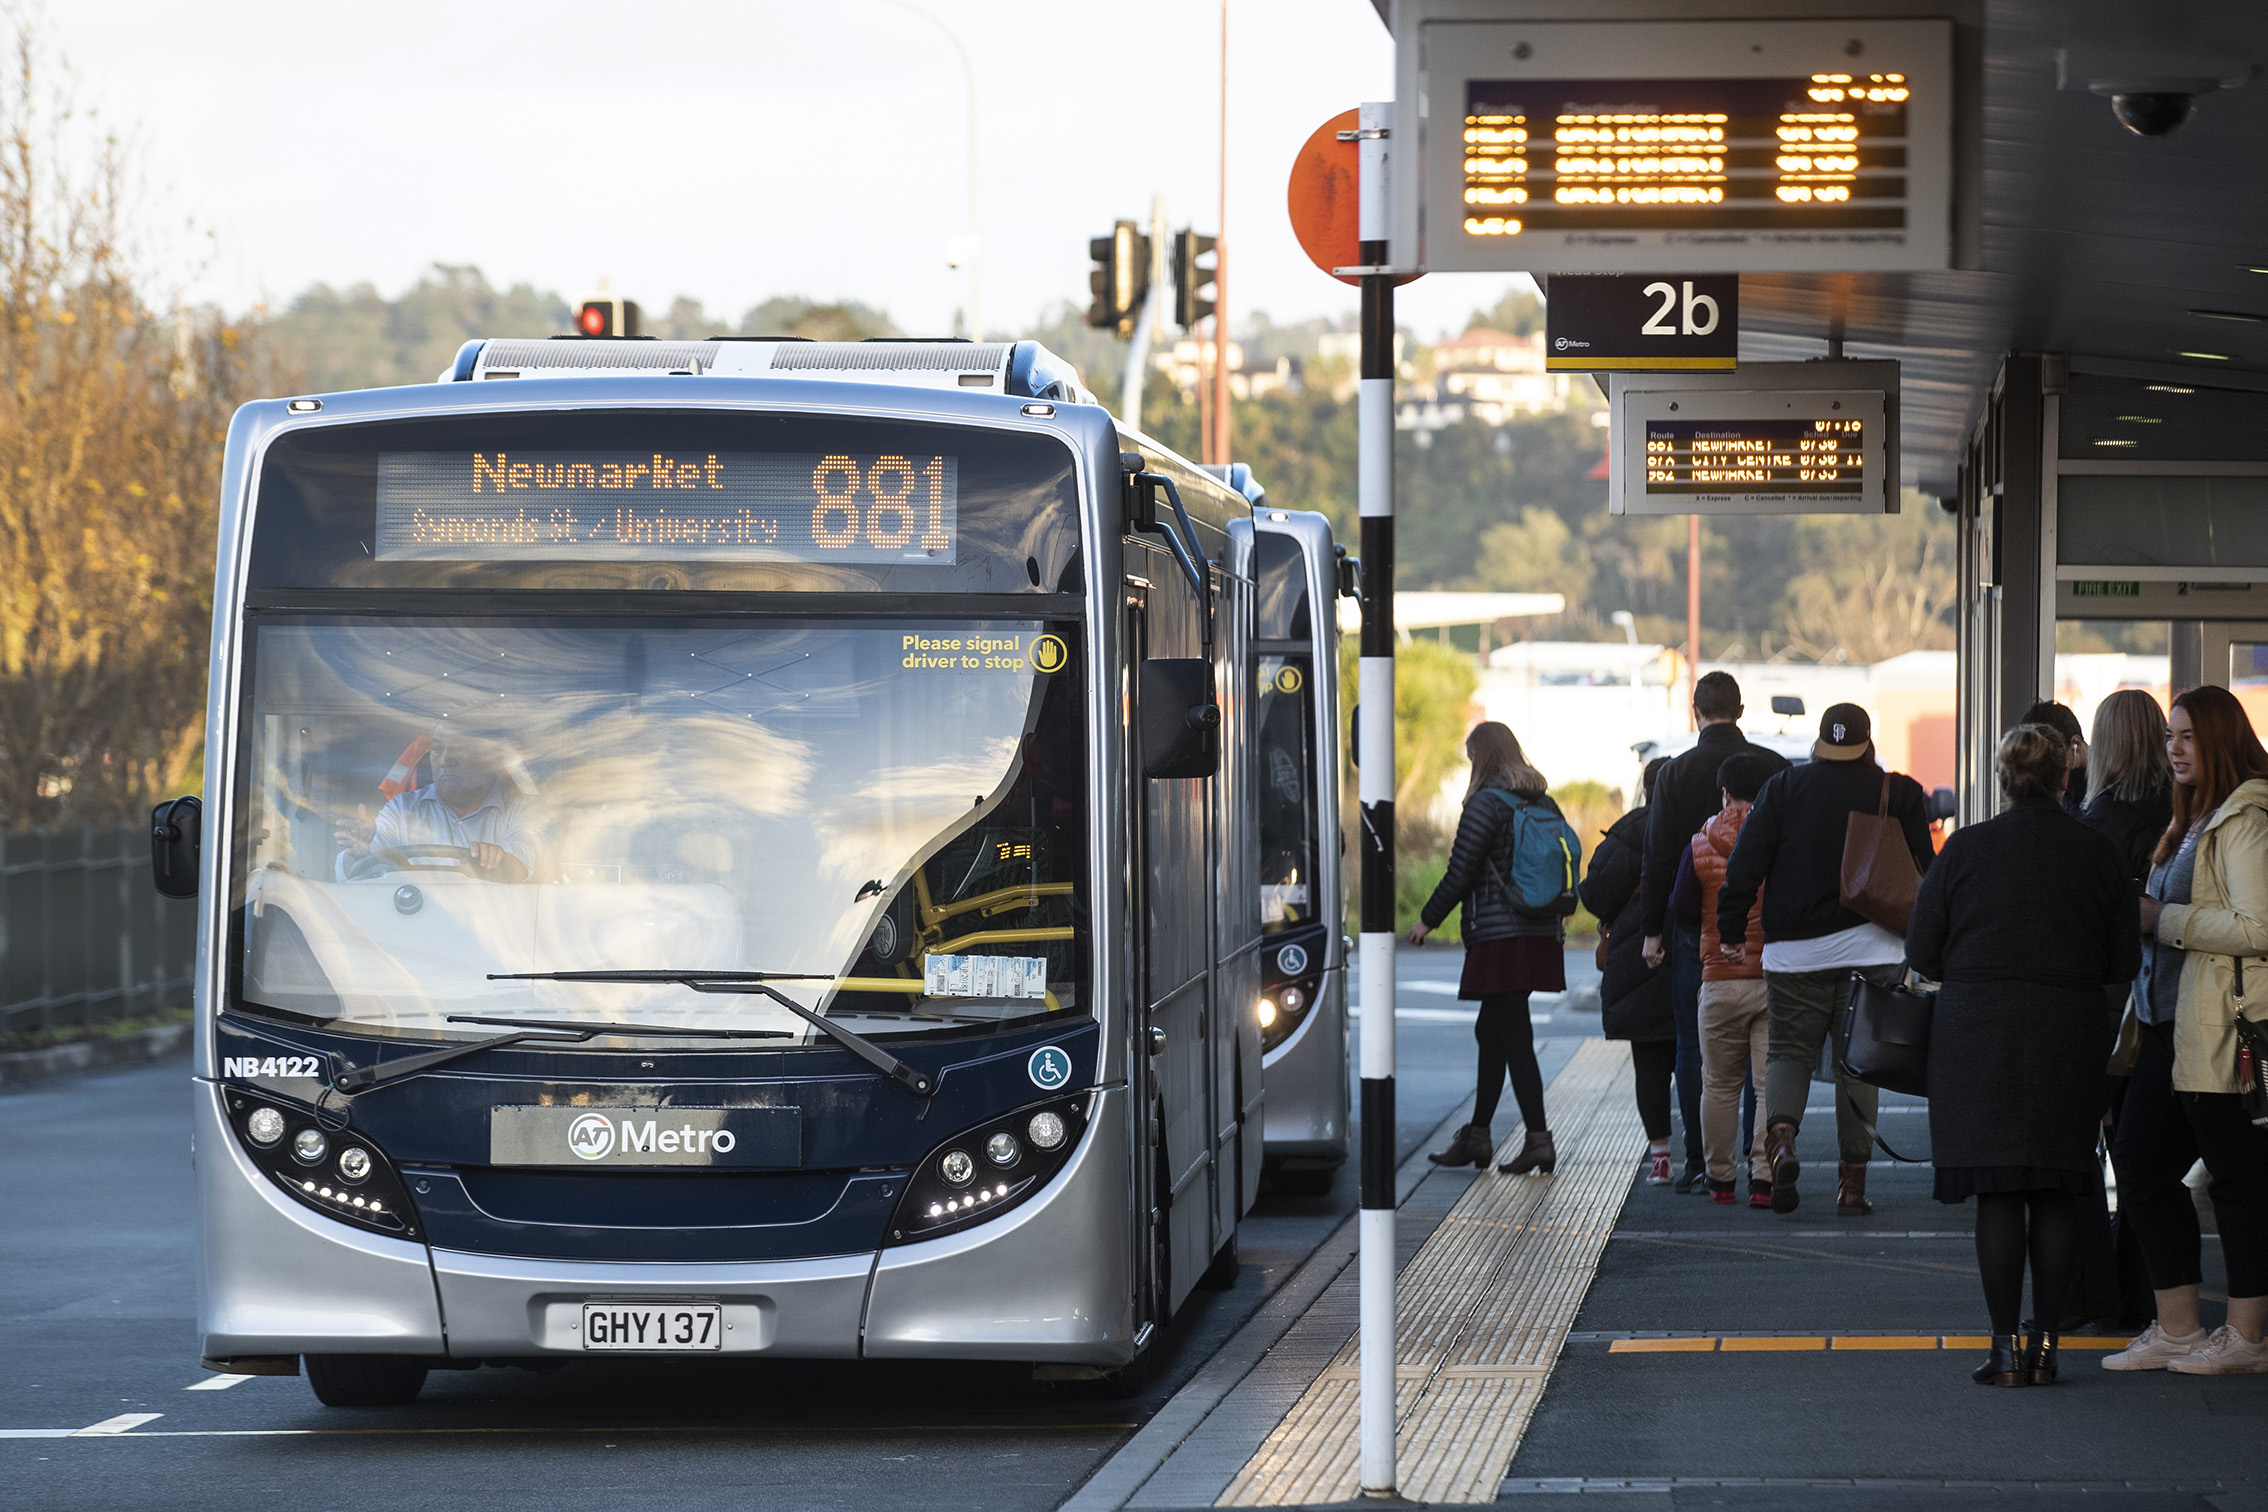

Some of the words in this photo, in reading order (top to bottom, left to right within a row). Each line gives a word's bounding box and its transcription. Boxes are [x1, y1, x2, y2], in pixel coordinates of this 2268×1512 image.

[1641, 281, 1719, 336] 2b
[1568, 340, 1590, 348] Metro
[1650, 431, 1674, 439] Route
[1694, 431, 1741, 439] Destination
[473, 453, 724, 493] Newmarket
[811, 455, 949, 548] 881
[413, 508, 539, 542] Symonds
[550, 508, 578, 542] St
[616, 508, 777, 543] University
[2079, 582, 2102, 596] FIRE
[2108, 582, 2132, 596] EXIT
[902, 635, 961, 651] Please
[966, 635, 1019, 655] signal
[902, 654, 956, 669] driver
[961, 655, 980, 669] to
[984, 655, 1024, 673] stop
[224, 1056, 319, 1078] NB4122
[621, 1120, 736, 1153] Metro
